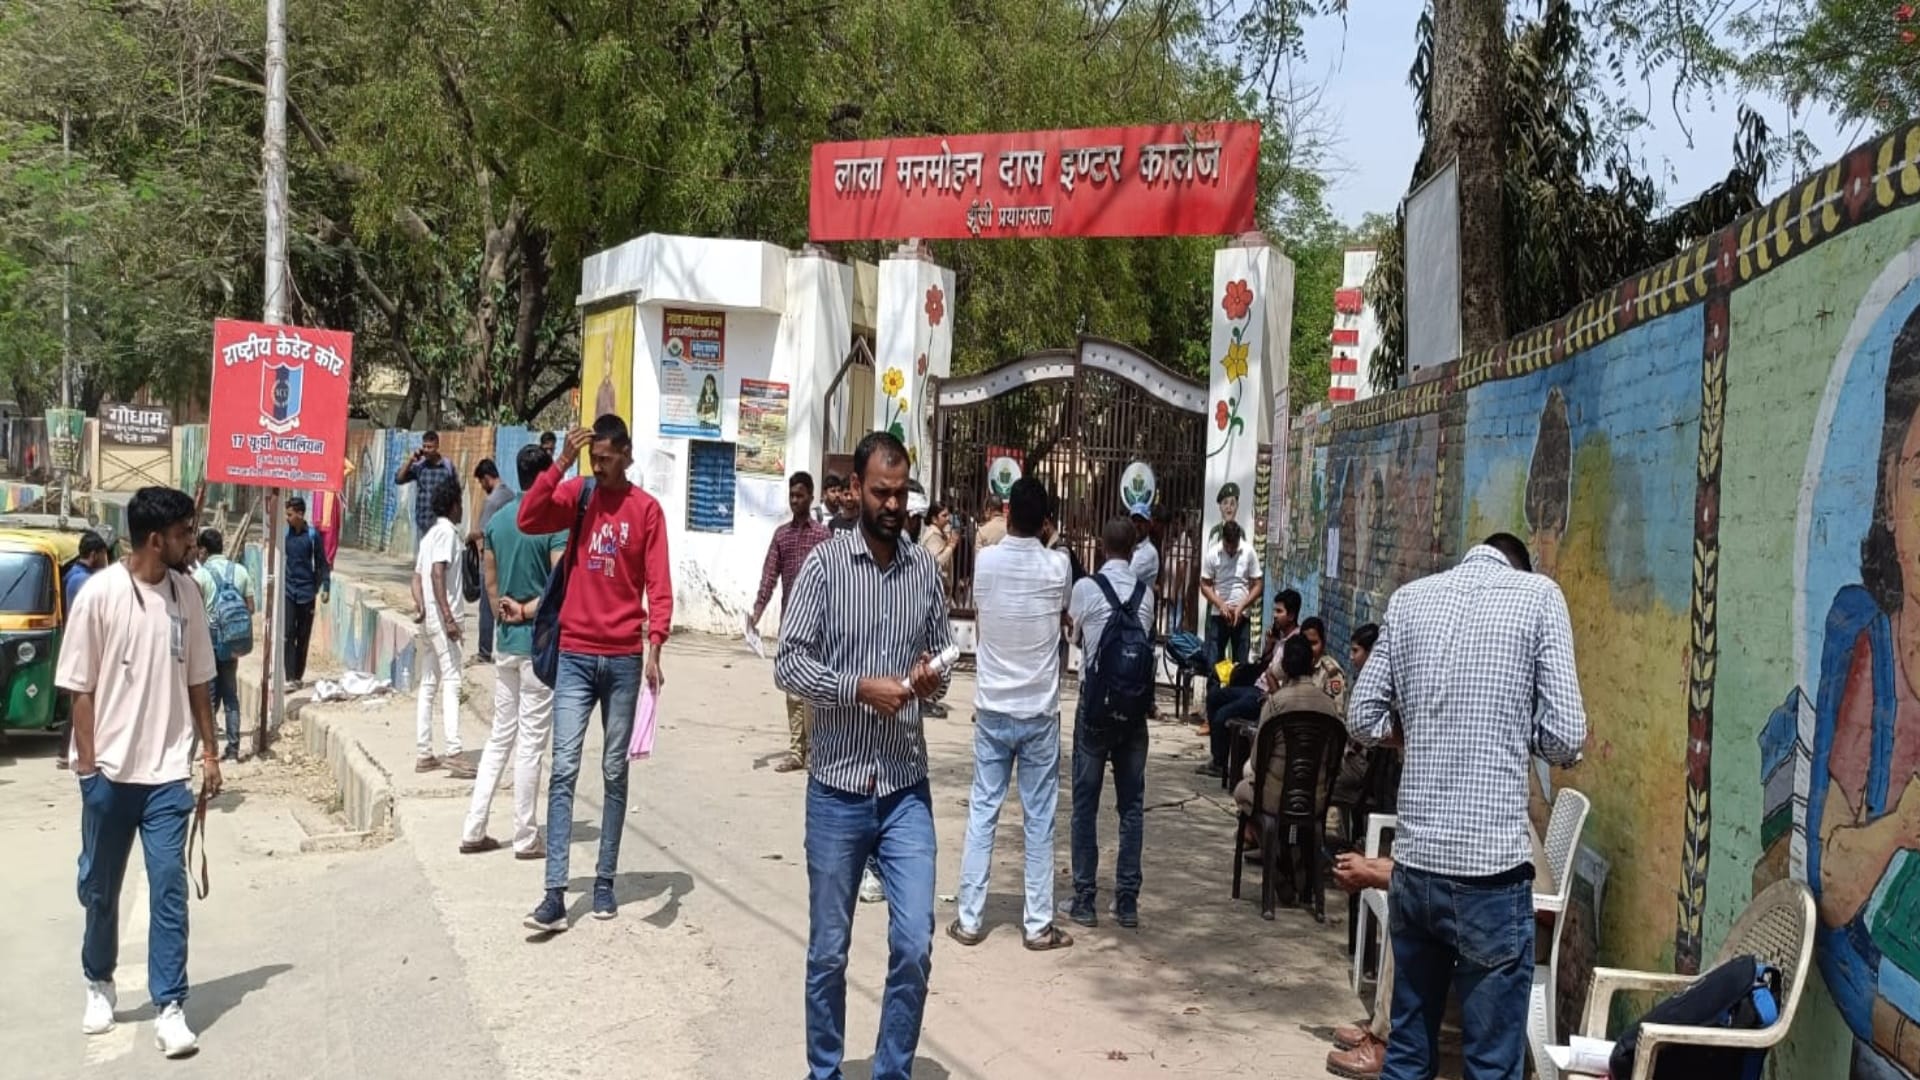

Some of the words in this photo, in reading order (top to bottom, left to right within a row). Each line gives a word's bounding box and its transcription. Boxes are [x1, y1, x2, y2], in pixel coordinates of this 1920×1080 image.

[834, 157, 884, 192] लाला
[896, 140, 984, 191] मनमोहन
[999, 149, 1045, 188] दास
[1060, 145, 1123, 192] इण्टर
[997, 206, 1053, 227] प्रयागराज
[222, 333, 271, 366] राष्ट्रीय
[276, 330, 312, 360] कैडेट
[315, 346, 344, 375] कोर
[109, 405, 163, 426] गोधाम
[232, 434, 244, 448] 17
[276, 435, 324, 454] बटालियन
